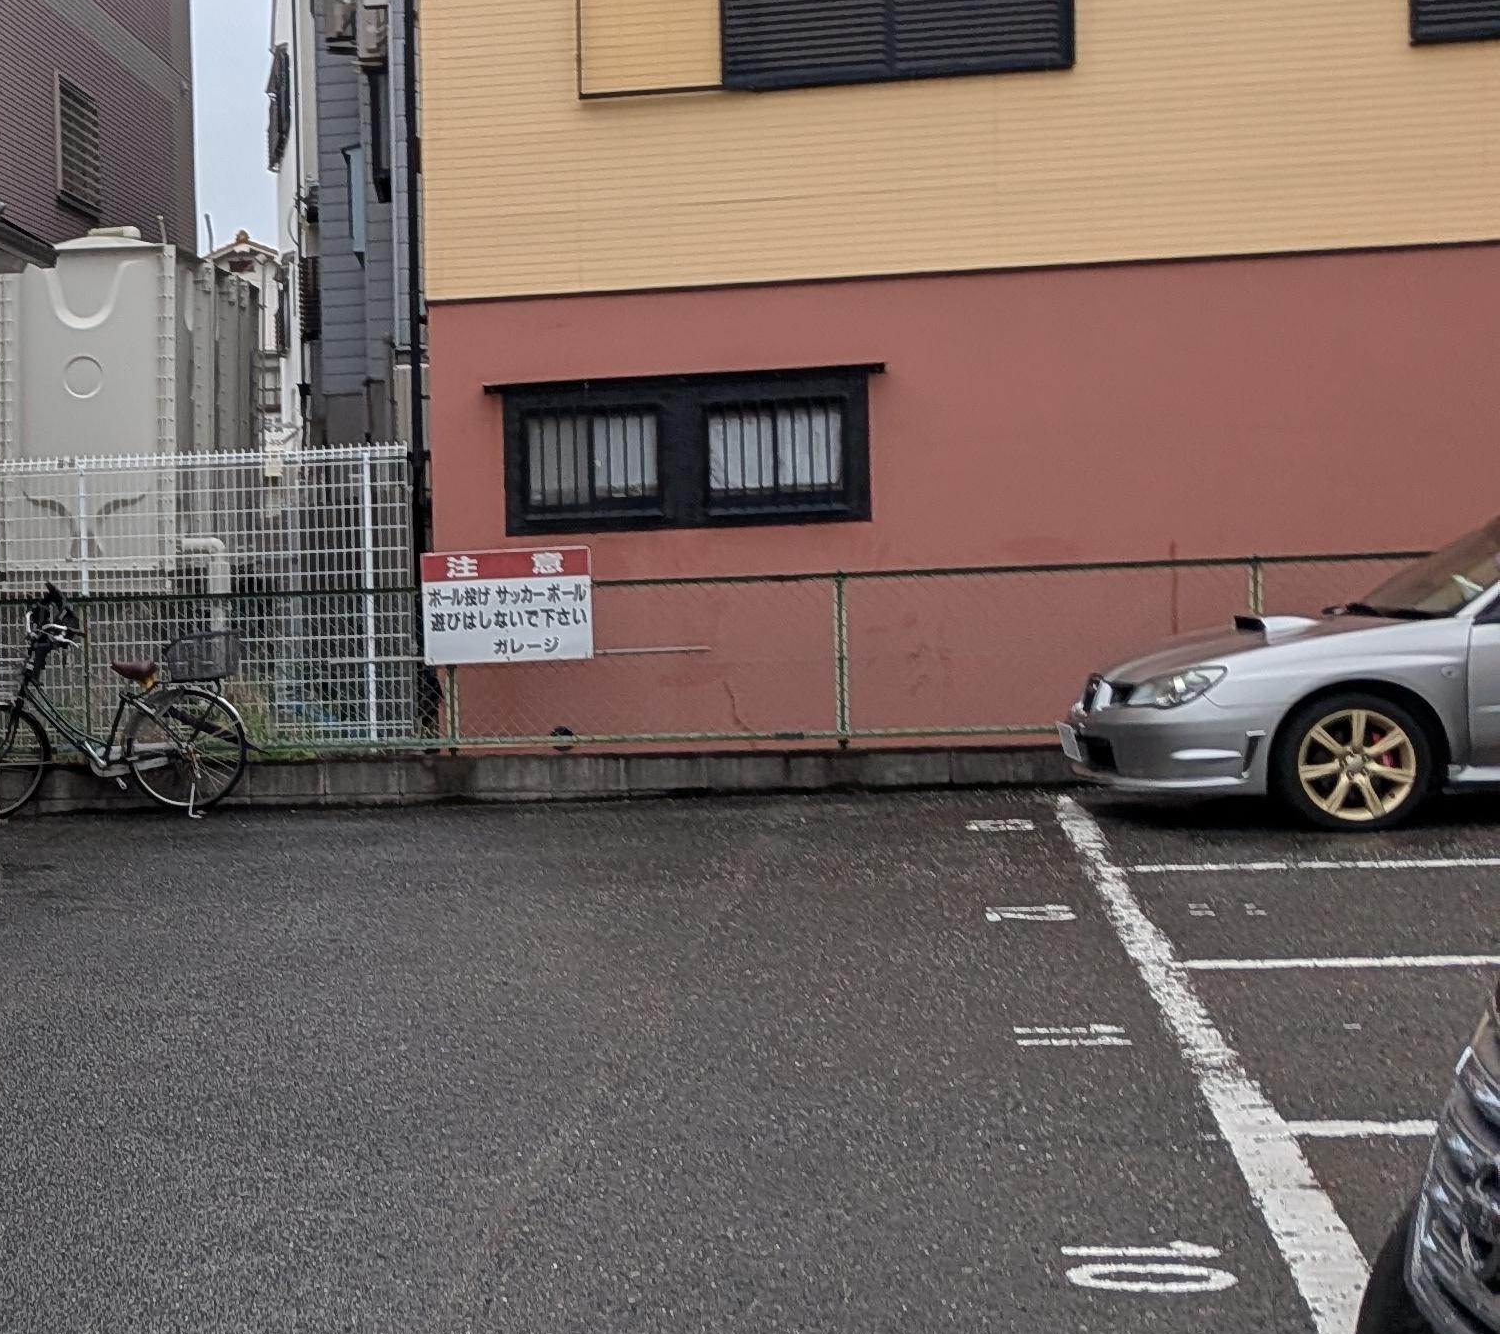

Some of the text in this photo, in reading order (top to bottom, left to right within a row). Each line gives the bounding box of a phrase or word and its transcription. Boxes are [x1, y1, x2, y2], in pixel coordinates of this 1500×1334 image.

[446, 552, 564, 578] 注意
[428, 583, 587, 608] ボール投げ サッカーボール
[430, 607, 588, 632] 遊びはしないで下さい
[493, 636, 560, 655] ガレージ
[1060, 1241, 1239, 1293] 10
